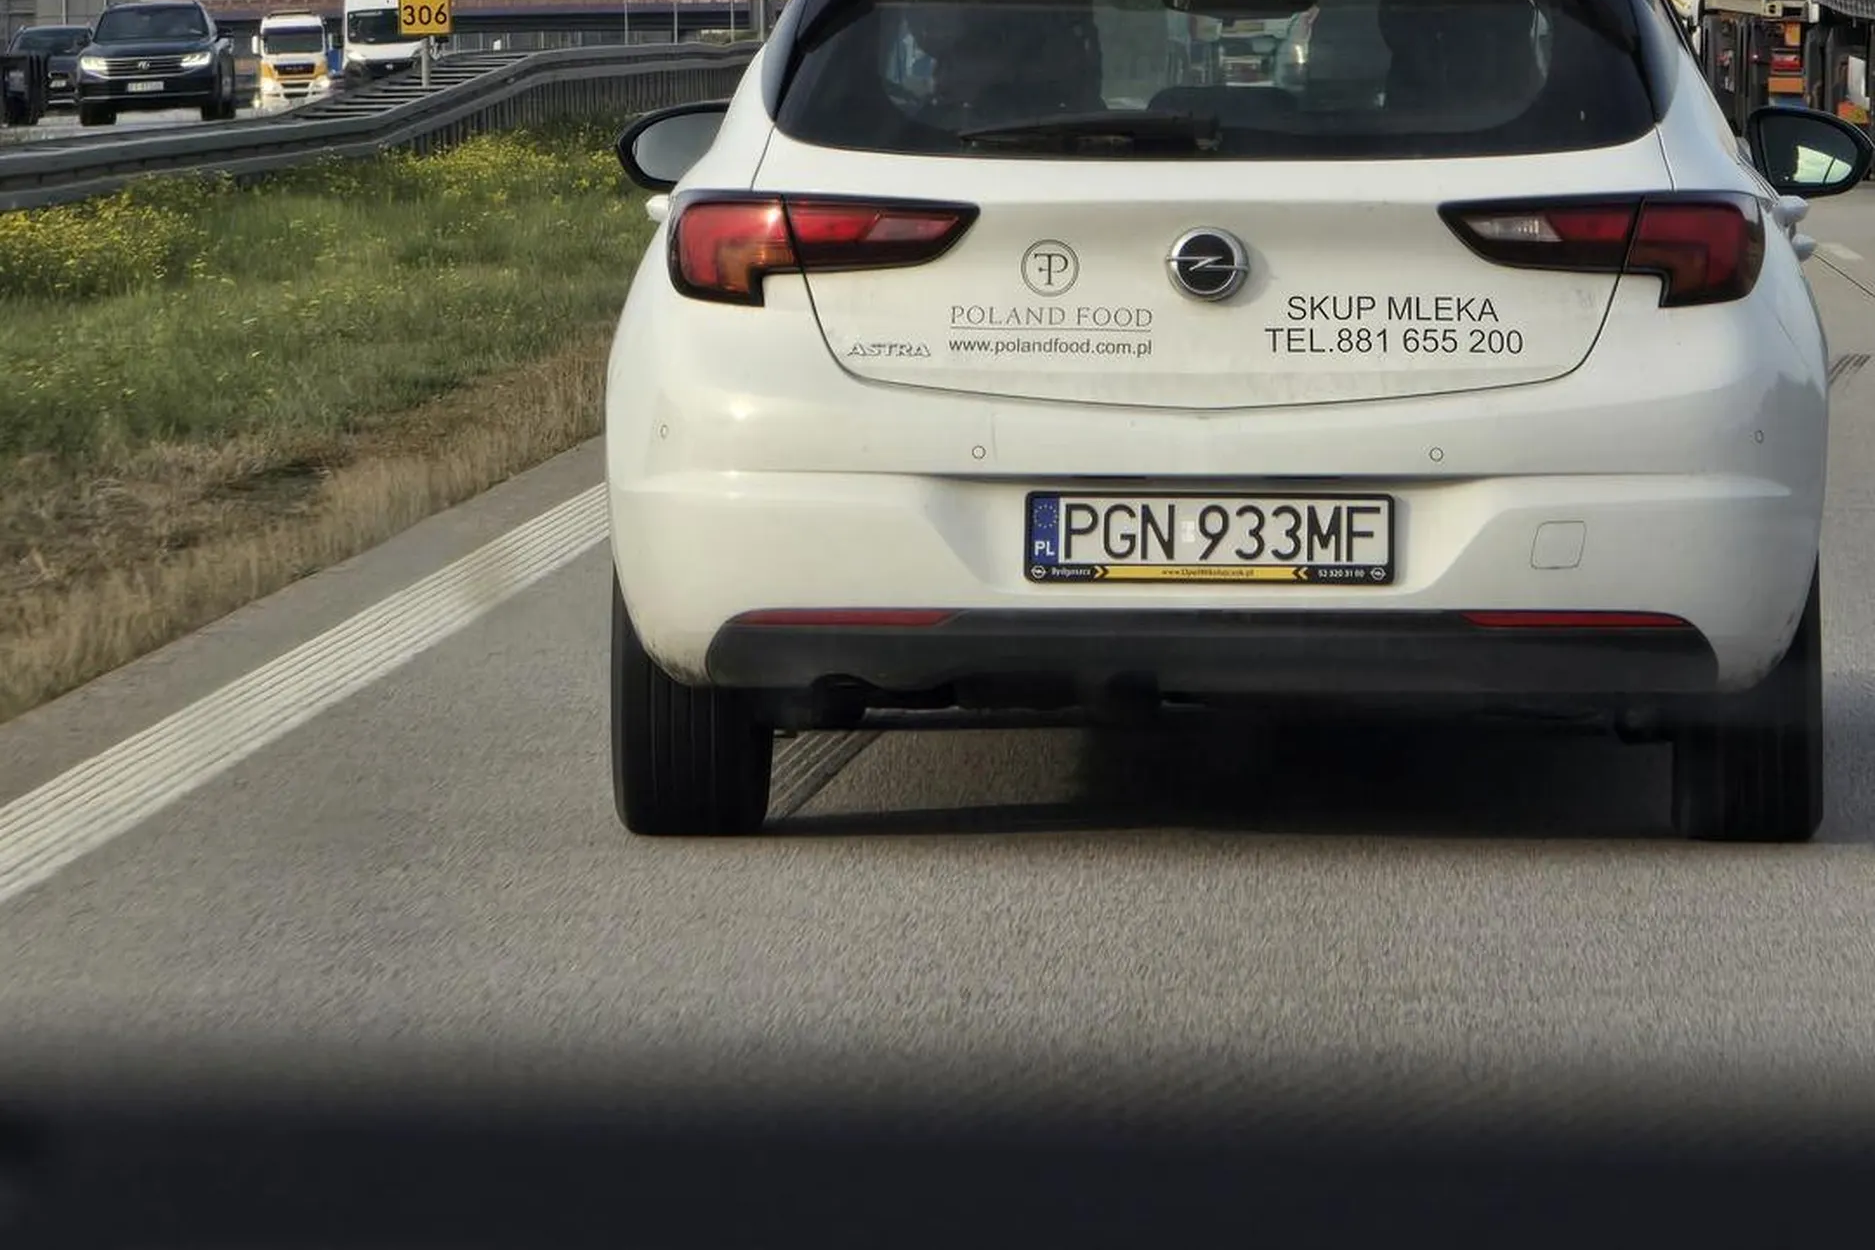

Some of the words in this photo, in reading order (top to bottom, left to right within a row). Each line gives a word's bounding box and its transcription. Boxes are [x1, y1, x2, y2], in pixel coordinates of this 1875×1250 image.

[403, 3, 447, 25] 306
[950, 305, 1066, 326] POLAND
[1076, 306, 1153, 327] FOOD
[1287, 296, 1376, 321] SKUP
[1388, 296, 1499, 321] MLEKA
[848, 342, 931, 357] ASTRA
[949, 337, 1152, 357] www.polandfood.com.pl
[1265, 328, 1388, 353] TEL.881
[1403, 328, 1457, 353] 655
[1469, 329, 1523, 354] 200
[1064, 503, 1176, 560] PGN
[1199, 504, 1381, 562] 933MF
[1034, 541, 1055, 556] PL
